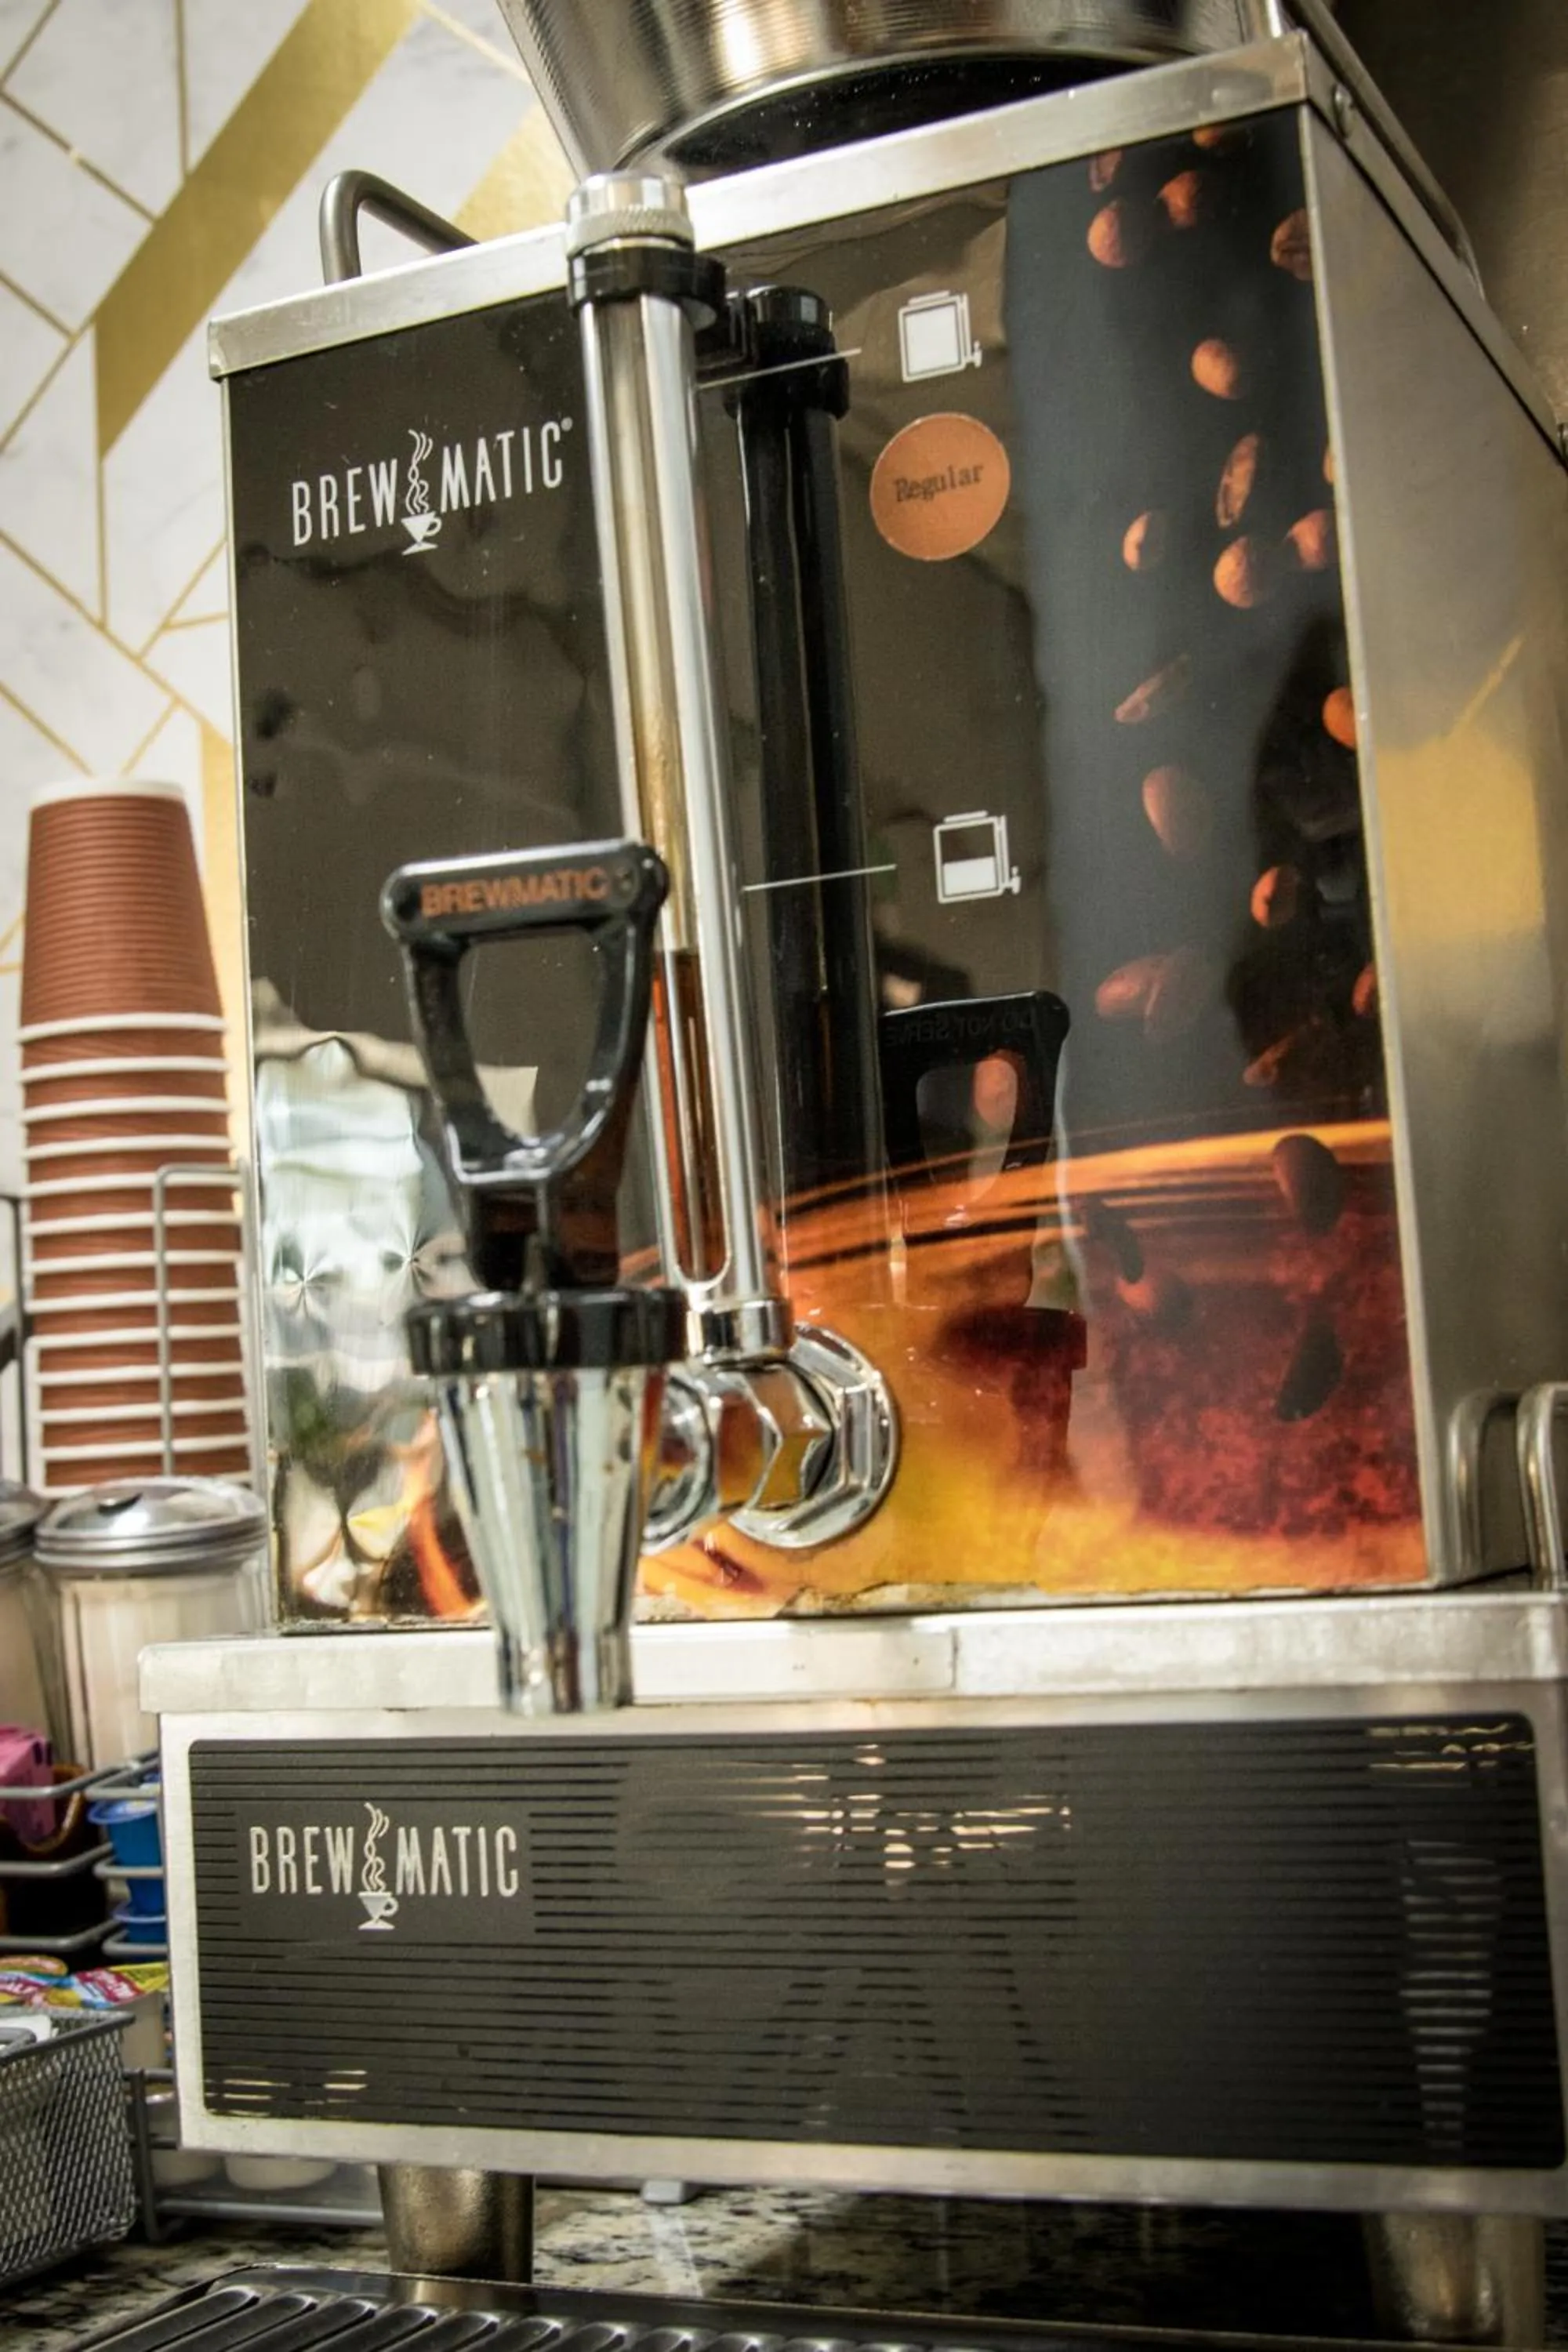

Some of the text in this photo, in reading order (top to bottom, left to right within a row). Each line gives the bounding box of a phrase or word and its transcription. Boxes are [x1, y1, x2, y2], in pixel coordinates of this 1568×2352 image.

[292, 459, 398, 546] BREW
[894, 464, 984, 503] Regular
[419, 866, 609, 919] BREWMATIC
[249, 1825, 519, 1897] BREW MATIC
